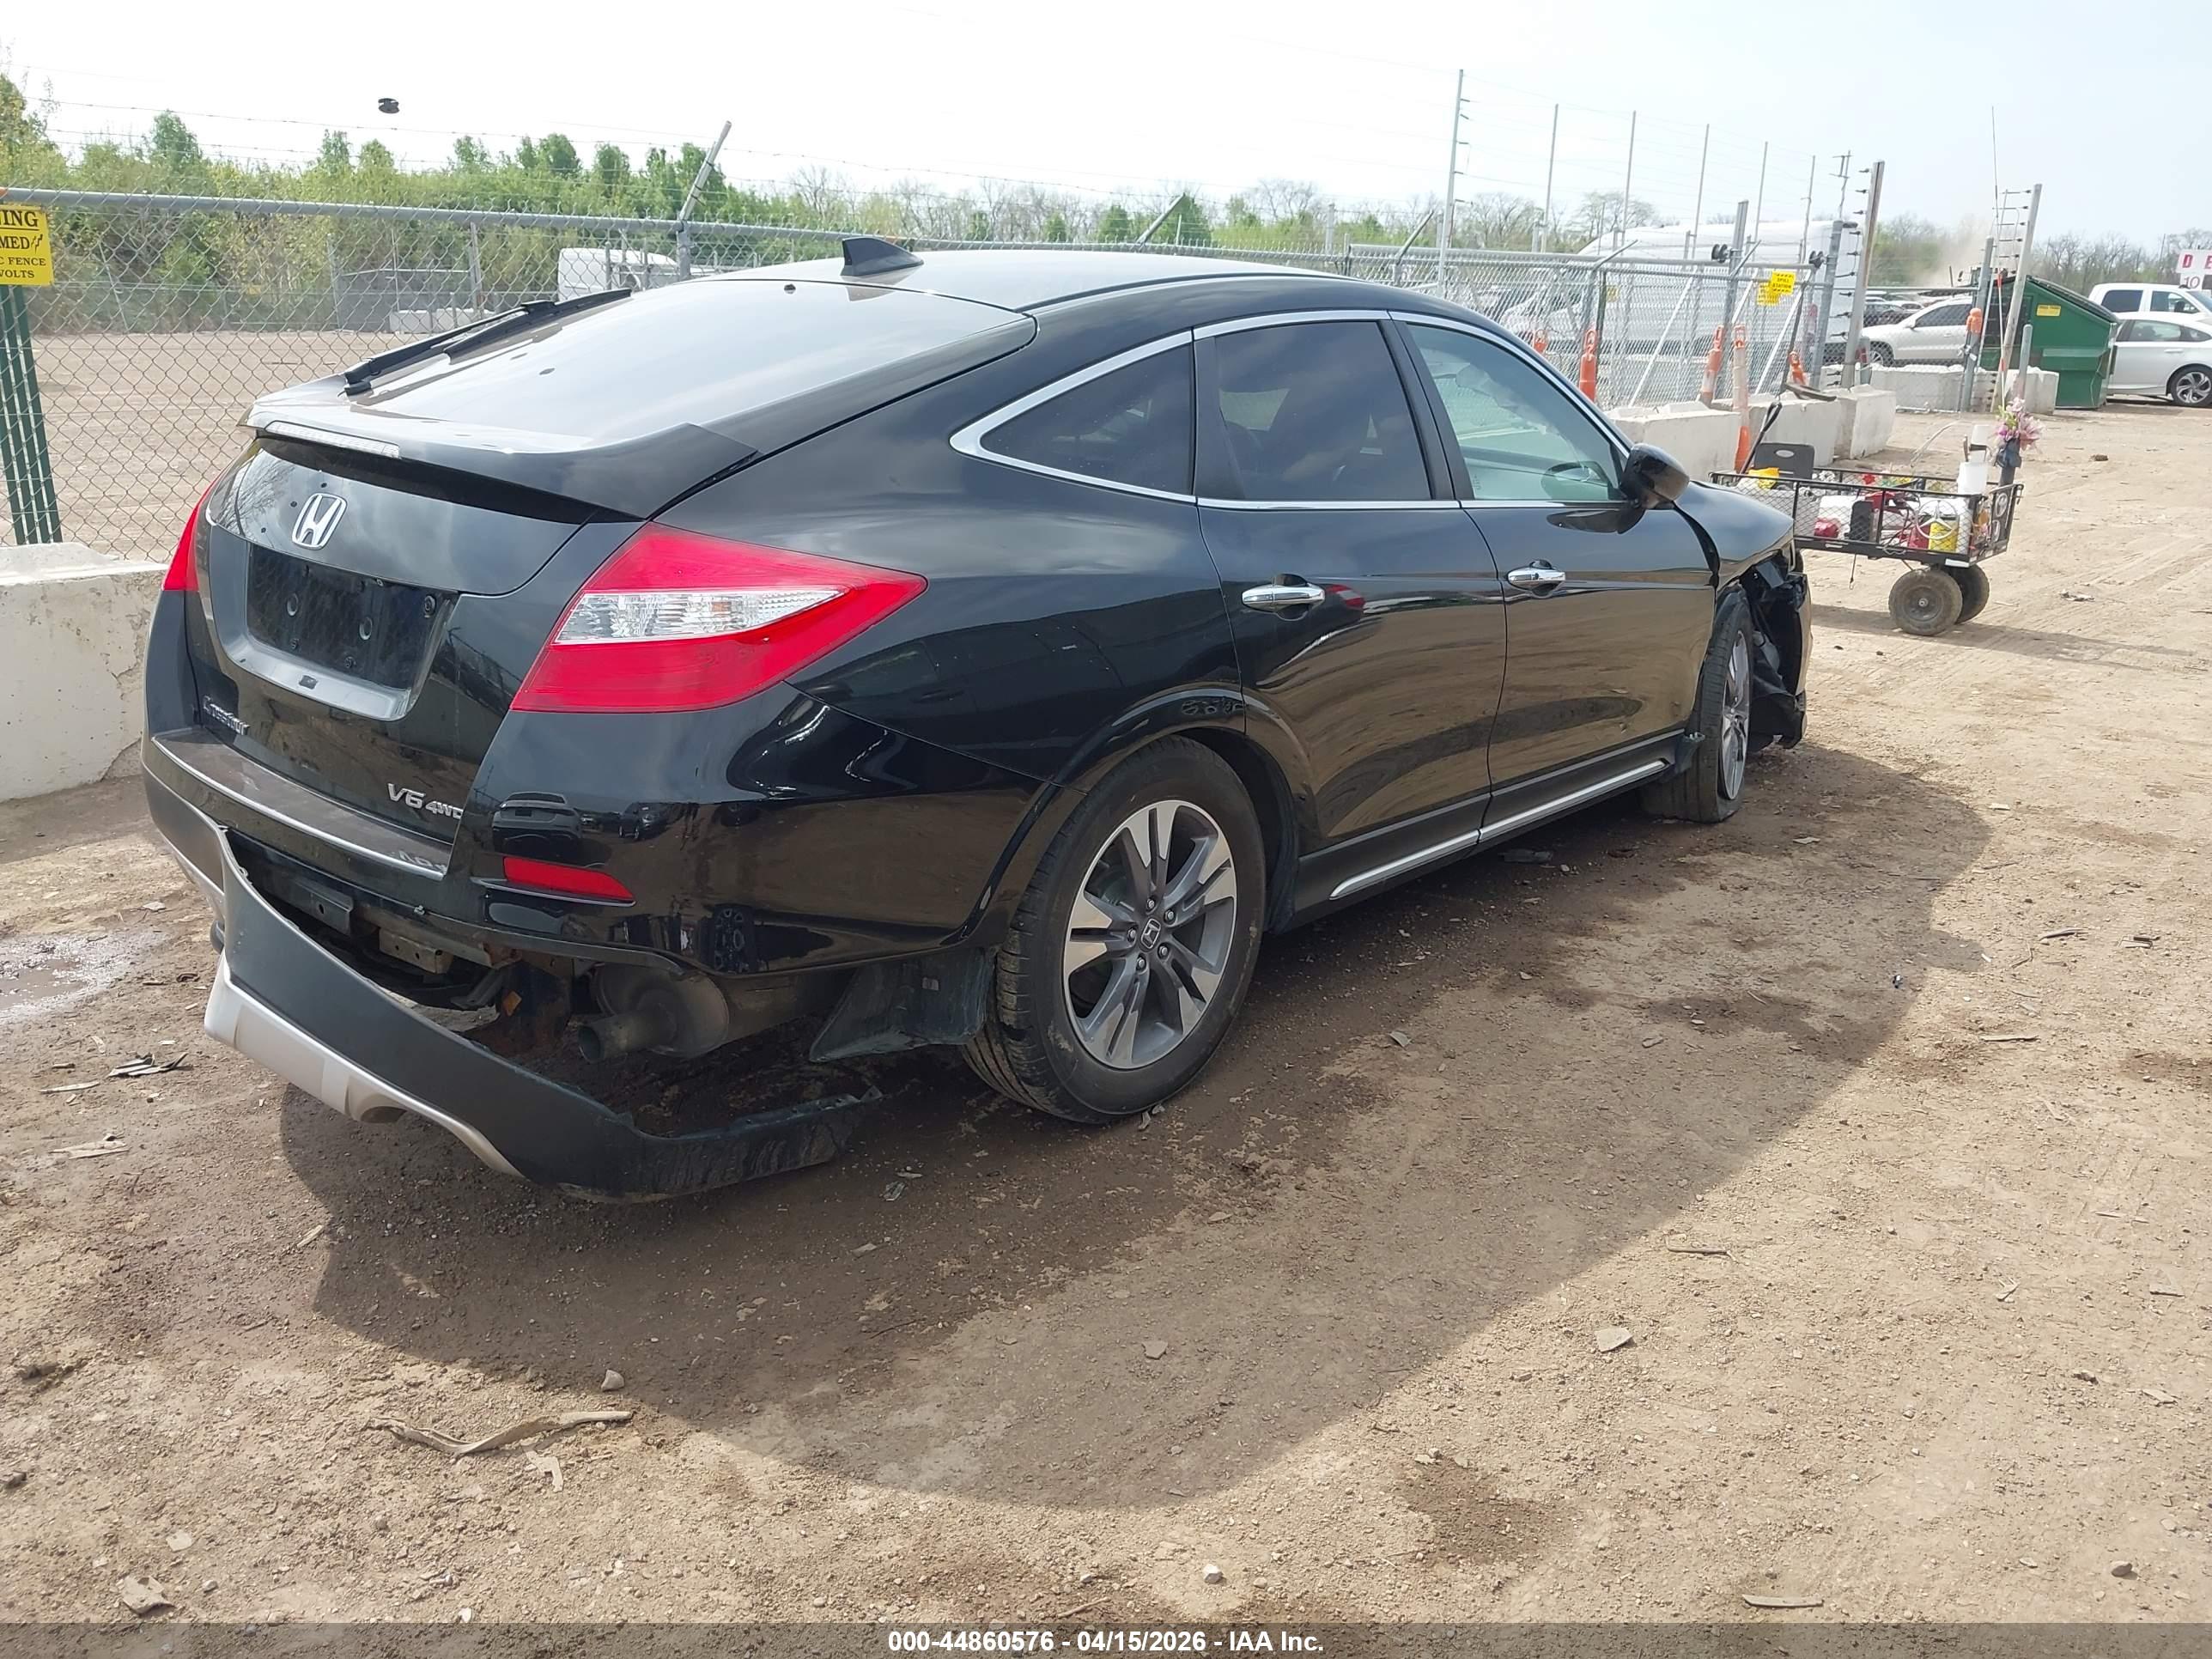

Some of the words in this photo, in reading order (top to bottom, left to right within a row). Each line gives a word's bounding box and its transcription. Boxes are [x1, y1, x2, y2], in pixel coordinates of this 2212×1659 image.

[0, 210, 39, 228] ING
[8, 257, 46, 266] FENCE
[387, 783, 426, 809] V6
[425, 800, 465, 820] 4WD
